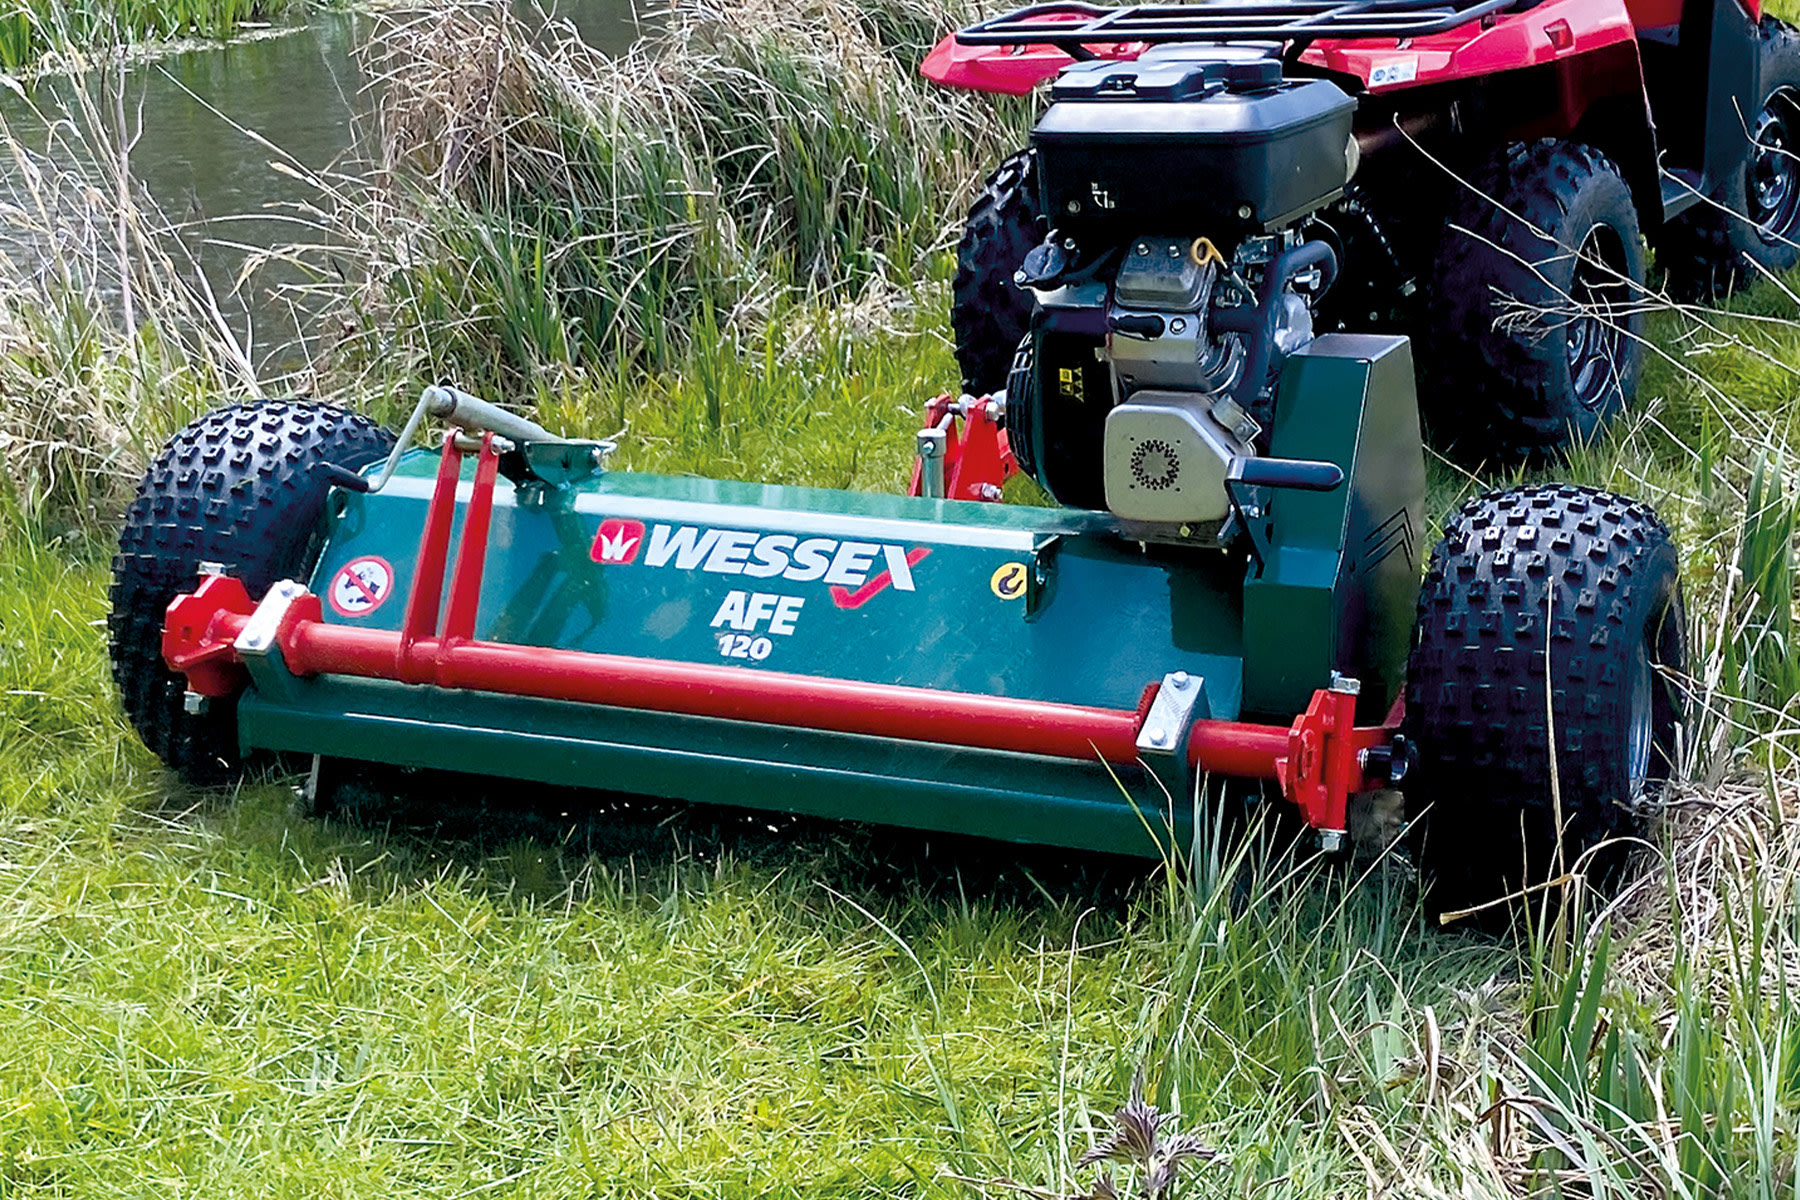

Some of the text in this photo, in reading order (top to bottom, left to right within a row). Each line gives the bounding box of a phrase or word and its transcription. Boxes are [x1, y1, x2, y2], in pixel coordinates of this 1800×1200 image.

[644, 524, 932, 608] WESSEX
[710, 590, 805, 635] AFE
[717, 634, 772, 660] 120
